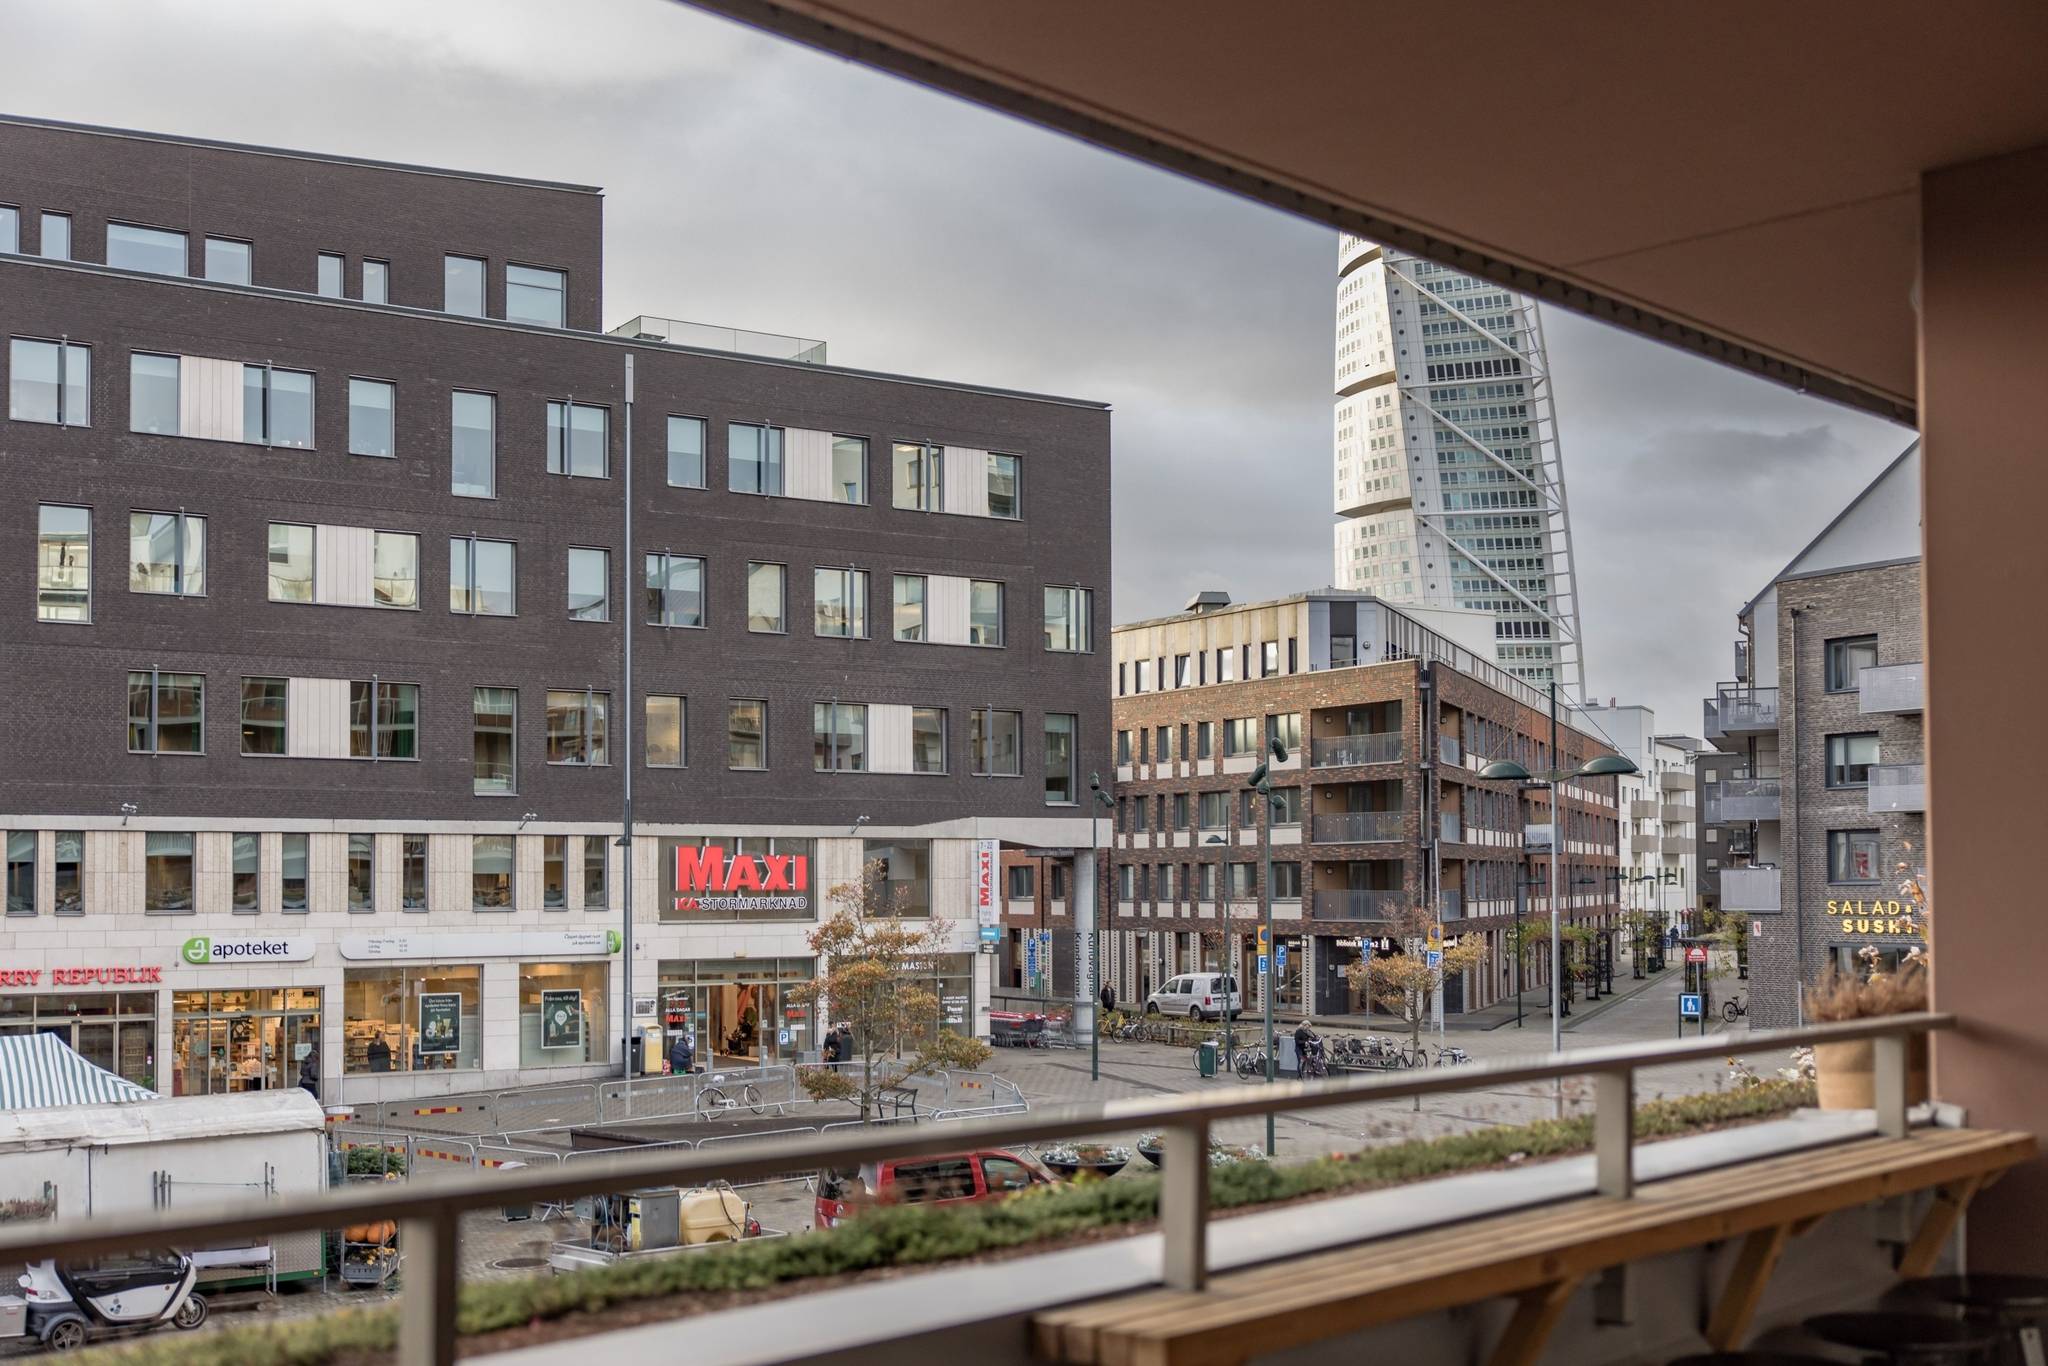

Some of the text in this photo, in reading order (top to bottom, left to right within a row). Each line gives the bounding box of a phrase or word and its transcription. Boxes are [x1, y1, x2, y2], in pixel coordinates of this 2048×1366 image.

[675, 845, 808, 891] MAXI
[979, 852, 990, 906] MAXI
[1827, 900, 1900, 915] SALAD
[213, 941, 289, 959] apoteket
[1029, 939, 1035, 947] P
[1364, 940, 1369, 949] P
[1278, 946, 1285, 956] P
[52, 967, 162, 986] REPUBLIK
[781, 1033, 787, 1042] P
